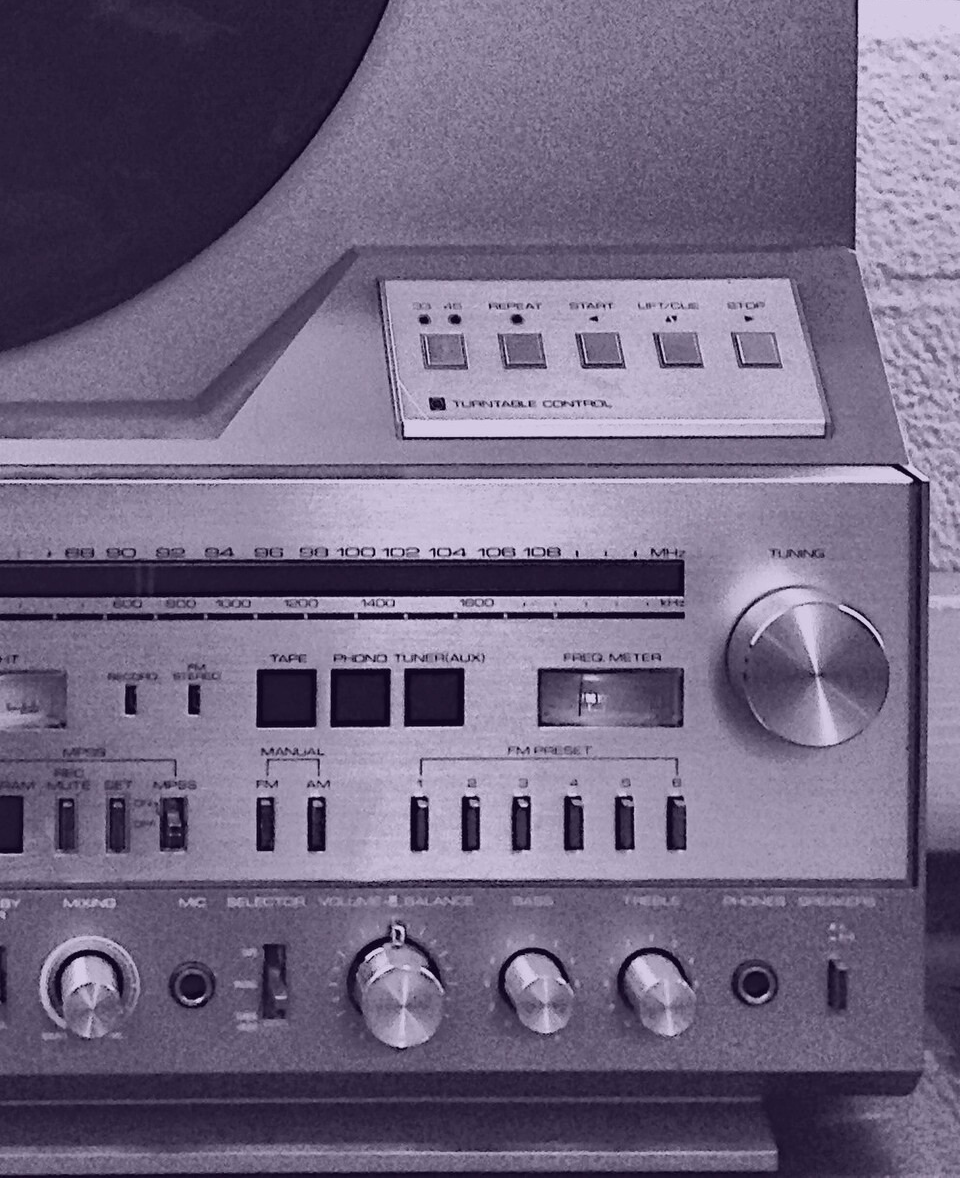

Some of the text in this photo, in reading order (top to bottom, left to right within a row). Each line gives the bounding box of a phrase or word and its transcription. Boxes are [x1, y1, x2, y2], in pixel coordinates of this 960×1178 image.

[488, 302, 543, 310] REPEAT
[568, 302, 615, 311] START
[727, 302, 766, 310] STOP
[452, 398, 613, 409] TURNTABLE CONTROL
[65, 547, 94, 558] 88
[106, 547, 136, 558] 90
[156, 547, 185, 558] 92
[204, 547, 234, 558] 94
[253, 547, 284, 558] 96
[299, 547, 329, 558] 98
[336, 547, 376, 558] 100
[382, 547, 421, 558] 102
[428, 547, 467, 558] 104
[477, 547, 517, 558] 106
[523, 547, 562, 558] 108
[650, 547, 686, 558] MHz
[769, 548, 825, 558] TUNING
[361, 599, 396, 608] 1400
[271, 654, 307, 663] TAPE
[333, 654, 388, 663] PHONO
[393, 653, 486, 664] TUNER(AUX)
[609, 653, 662, 663] METER
[260, 747, 325, 757] MANUAL
[534, 745, 593, 755] PRESET
[306, 779, 331, 789] AM
[62, 897, 117, 909] MIXING
[178, 897, 208, 908] MIC
[227, 896, 307, 908] SELECTOR
[404, 896, 474, 906] BALANCE
